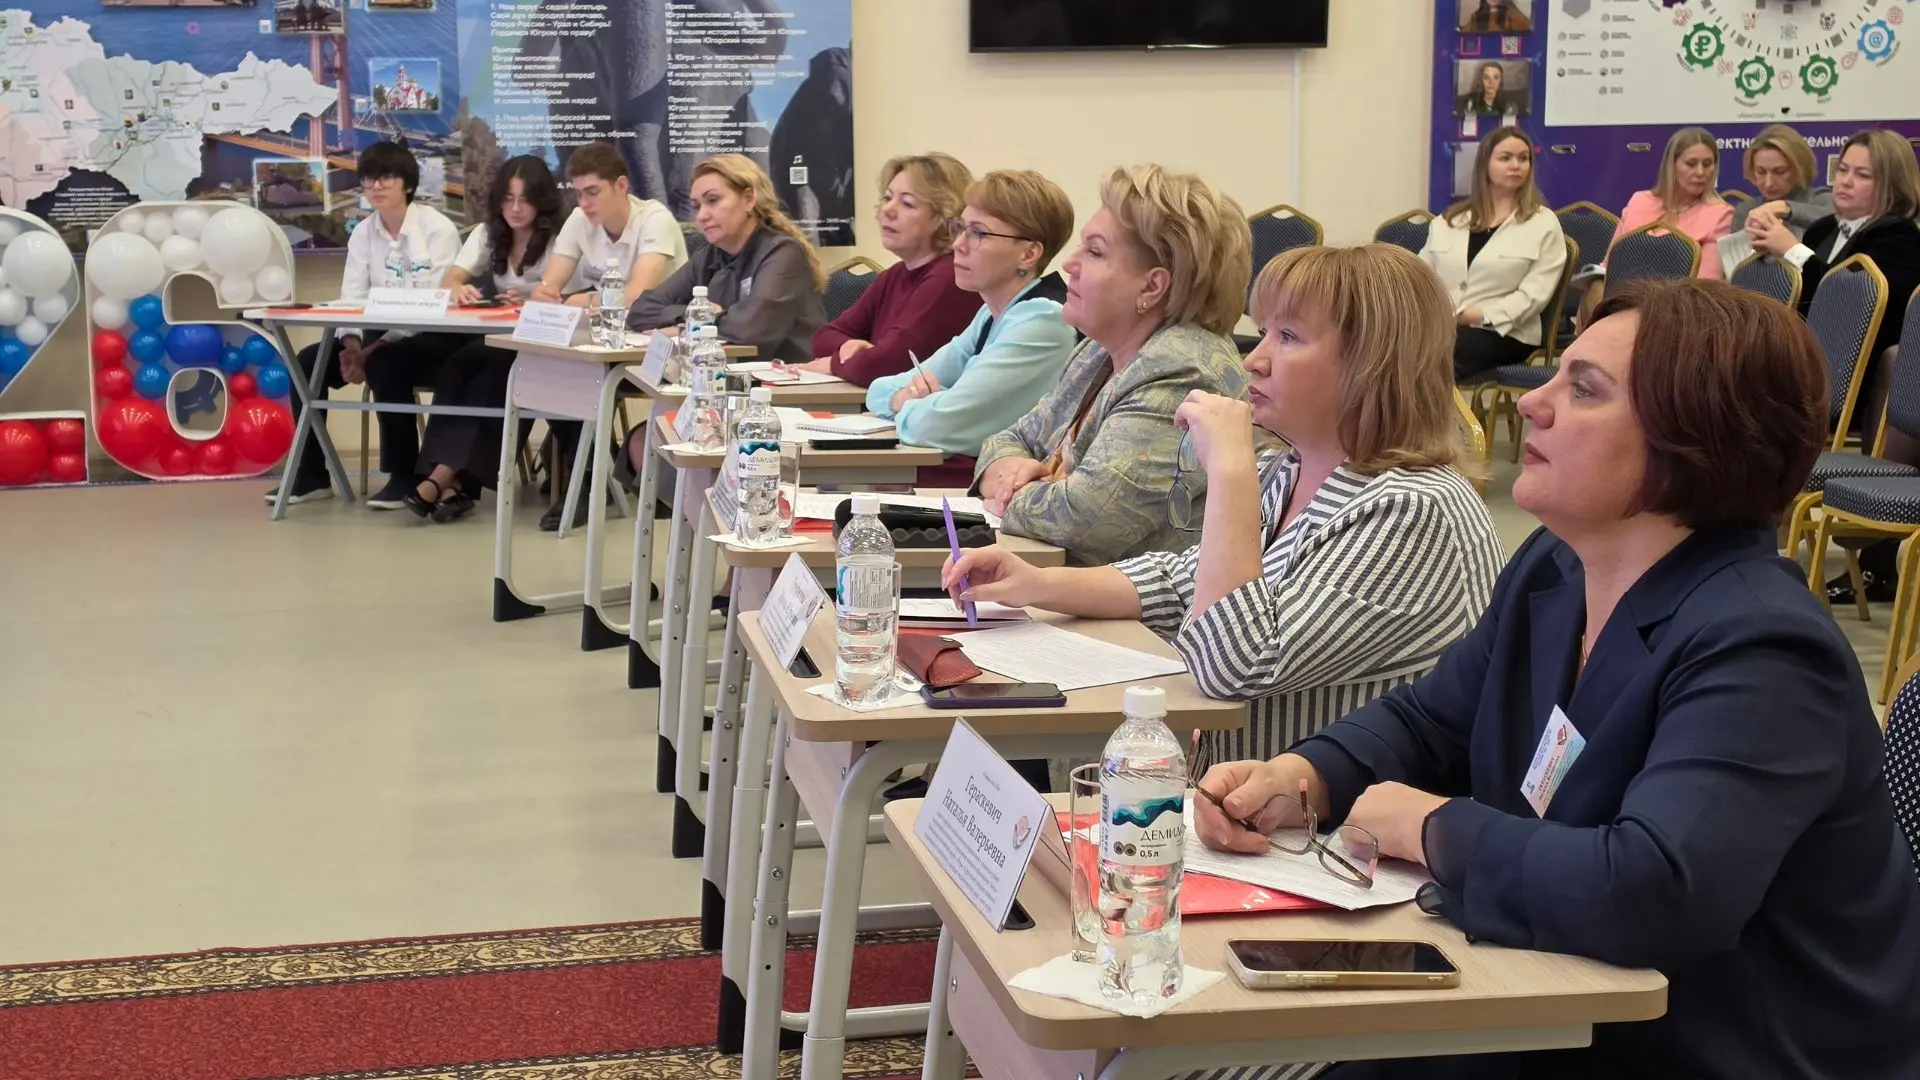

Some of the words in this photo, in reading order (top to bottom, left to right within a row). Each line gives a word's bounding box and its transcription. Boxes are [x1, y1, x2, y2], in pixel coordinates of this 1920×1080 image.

[942, 788, 969, 828] Наталья
[966, 814, 1007, 868] Валерьевна
[964, 776, 1002, 824] Гераскевич
